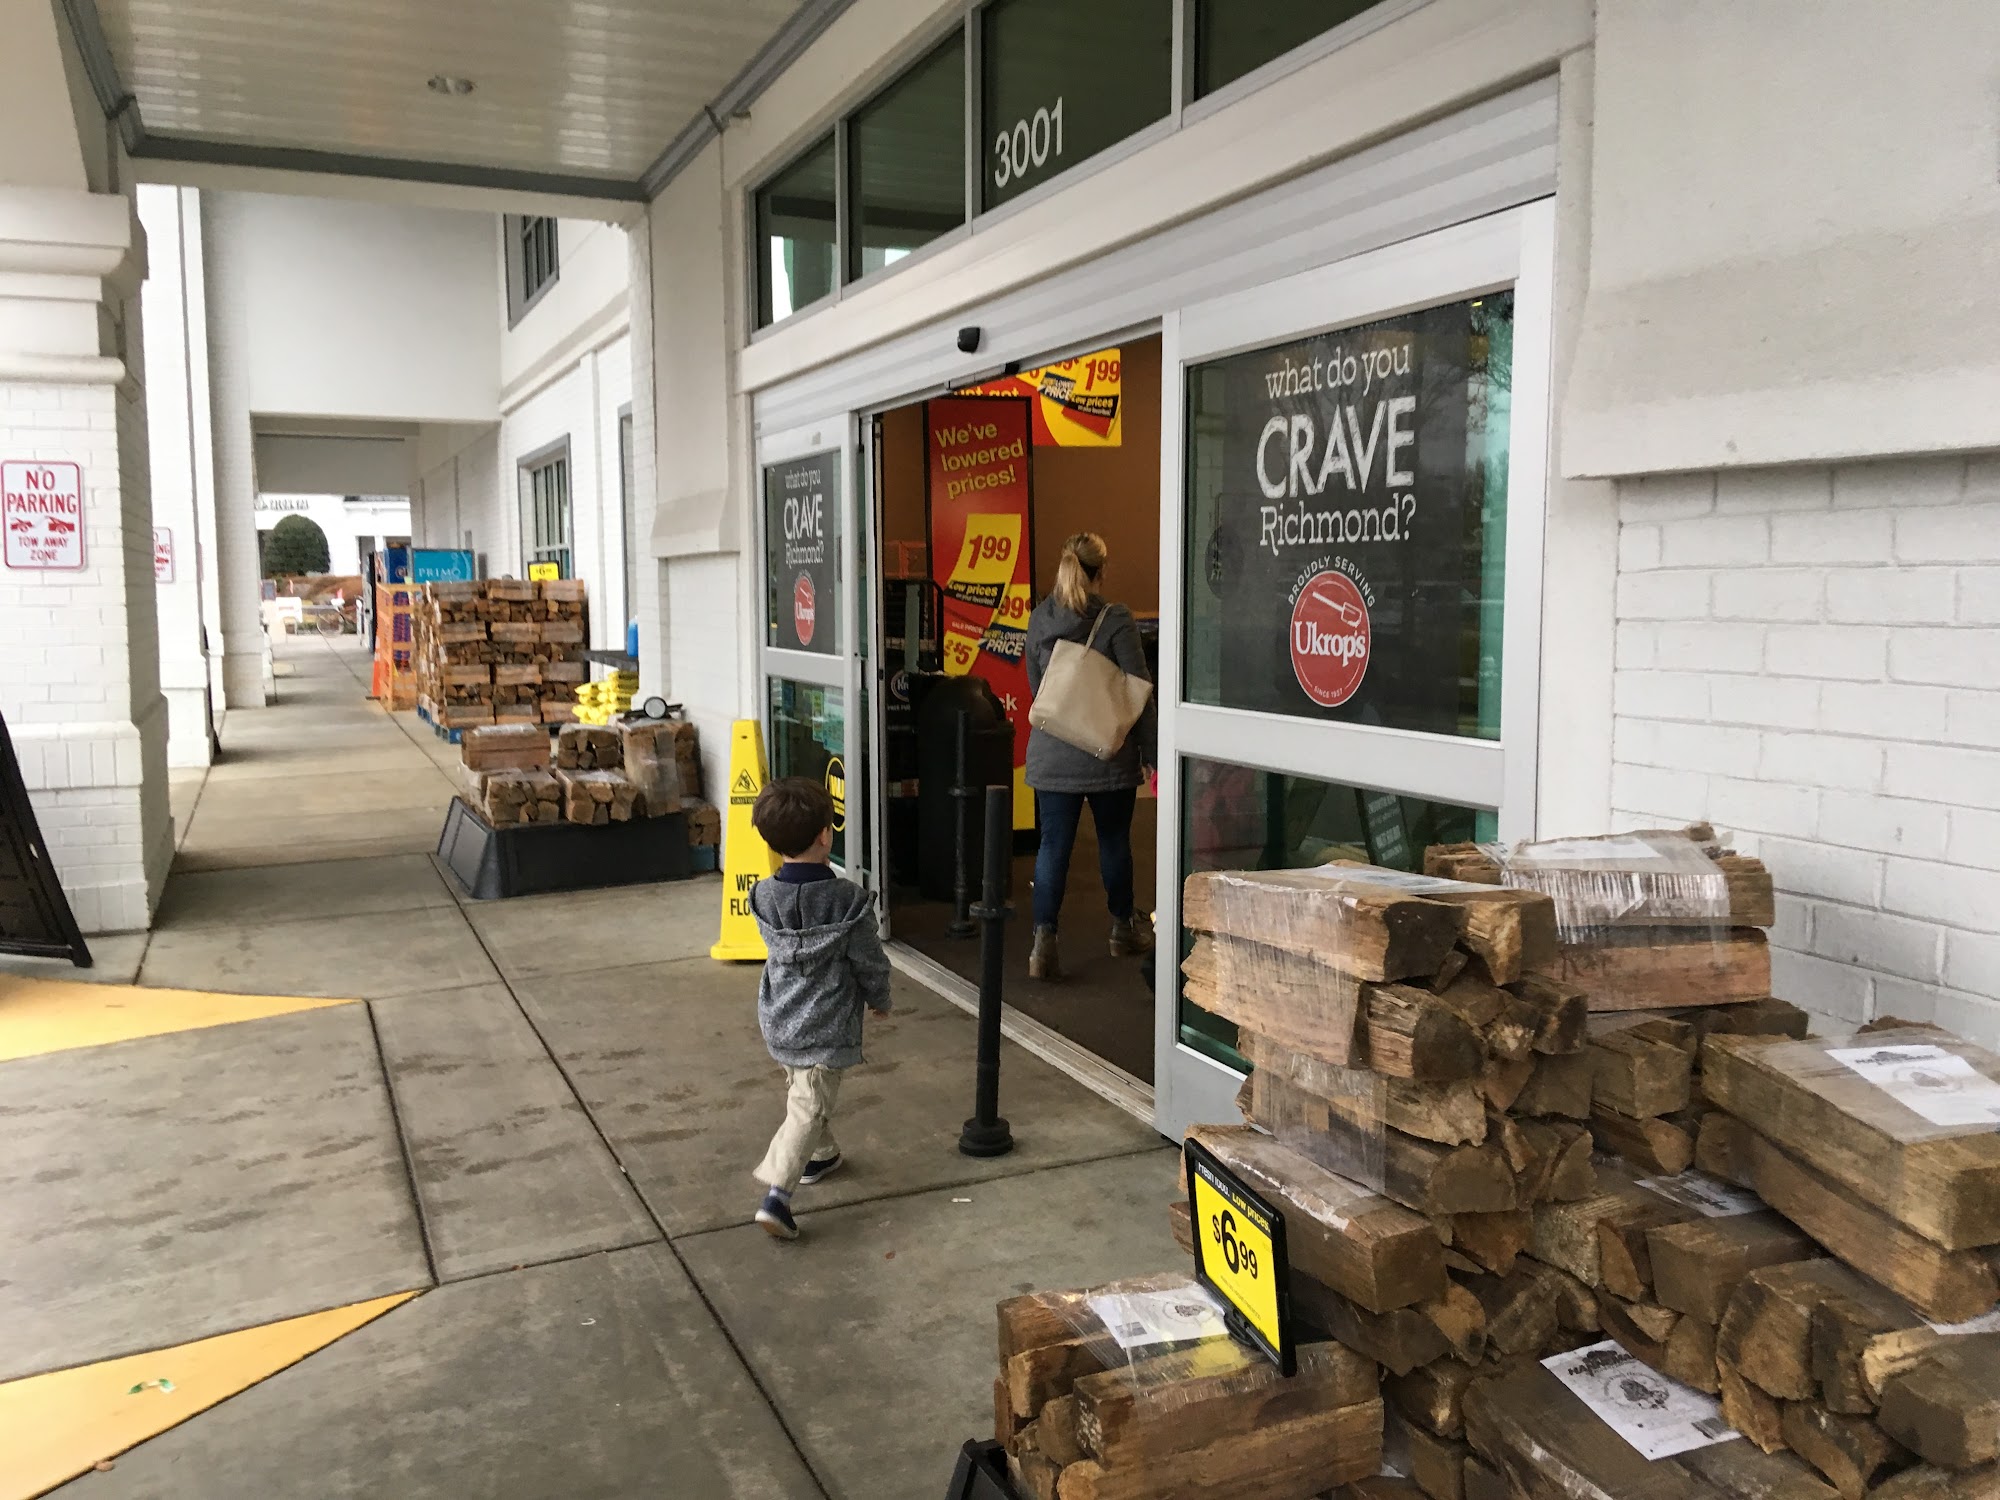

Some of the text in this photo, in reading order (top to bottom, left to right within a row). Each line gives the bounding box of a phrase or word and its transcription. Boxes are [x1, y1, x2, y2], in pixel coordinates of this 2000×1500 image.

[995, 96, 1063, 188] 3001
[1265, 344, 1410, 399] what do you
[935, 423, 998, 448] We've
[1256, 395, 1416, 499] CRAVE
[941, 437, 1024, 472] lowered
[26, 470, 55, 490] NO
[785, 466, 821, 492] what do you
[947, 464, 1017, 500] prices!
[7, 493, 77, 513] PARKING
[784, 493, 823, 540] CRAVE
[1260, 493, 1417, 556] Richmond?
[19, 537, 69, 548] TOW AWAY
[30, 549, 57, 561] ZONE
[418, 567, 461, 578] PRIMO
[1288, 555, 1375, 608] PROUDLY SERVING
[966, 583, 998, 598] prices
[985, 638, 1024, 657] PRICE
[1294, 621, 1366, 667] Ukrop's
[1314, 685, 1330, 698] SINCE
